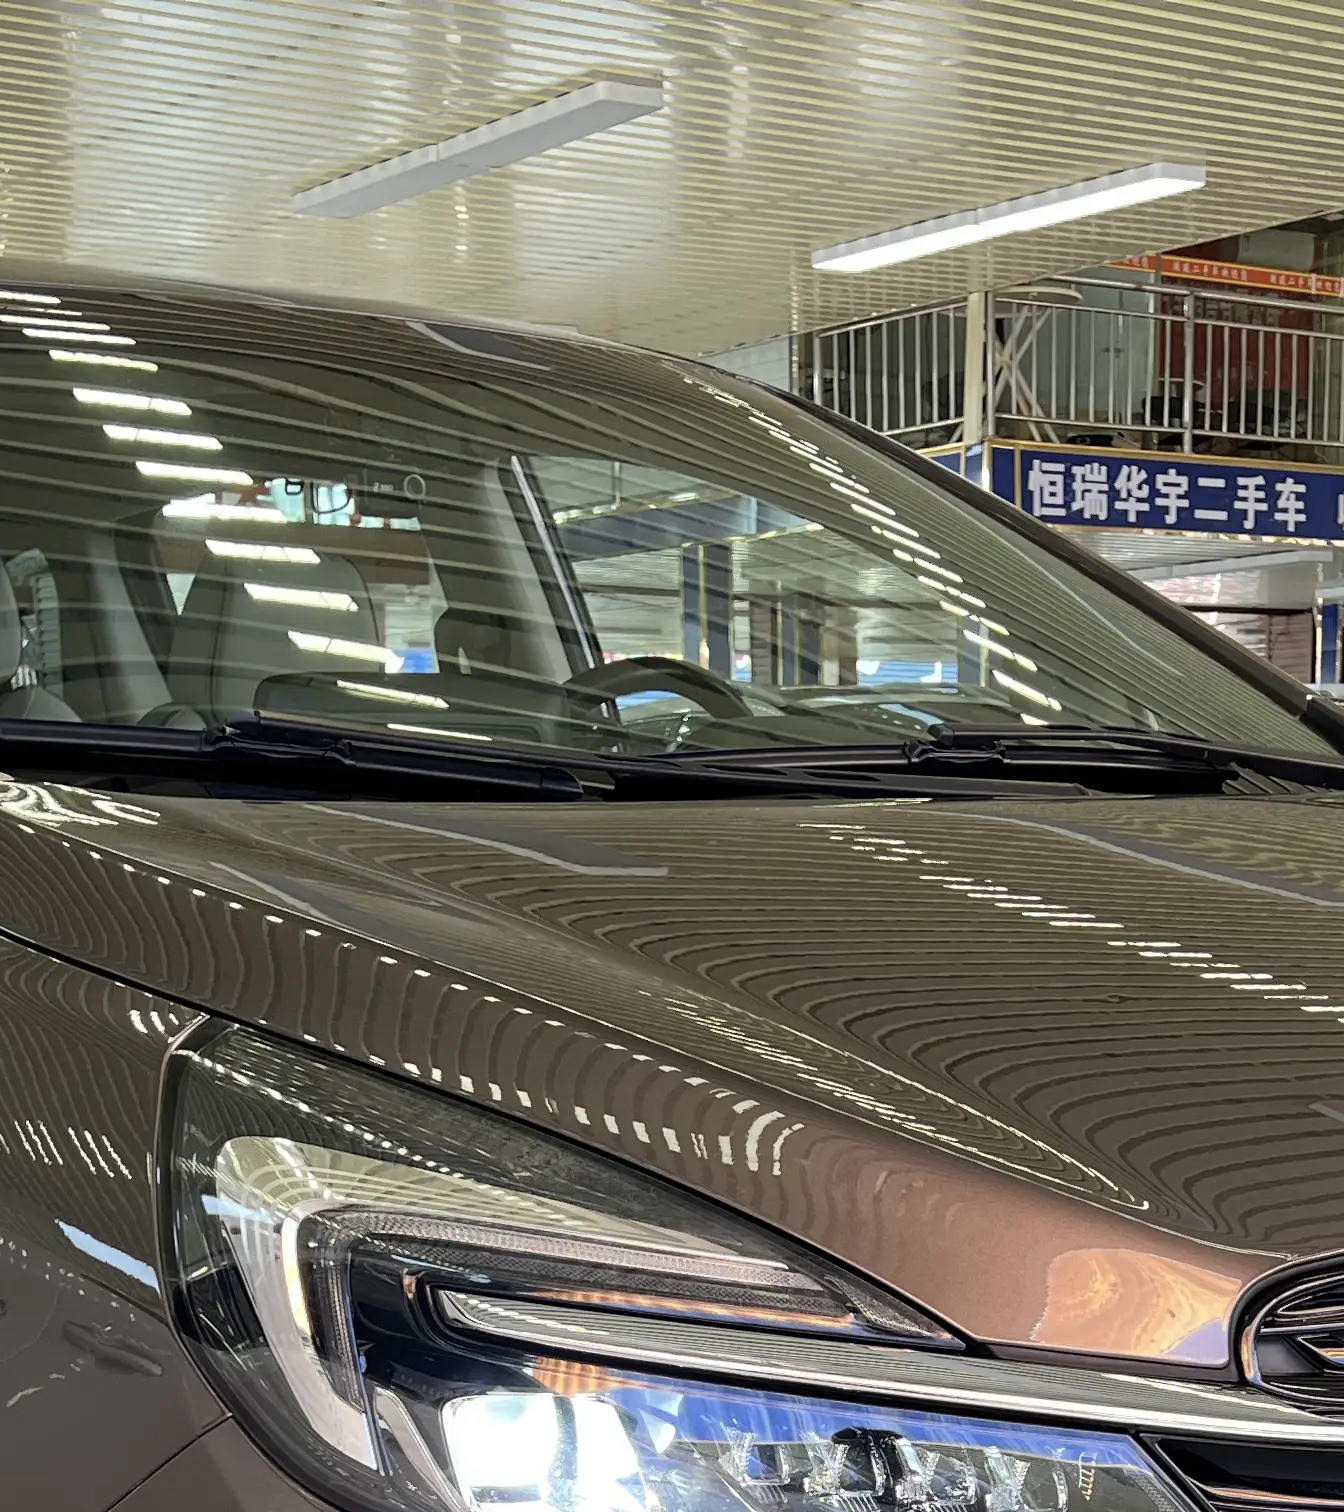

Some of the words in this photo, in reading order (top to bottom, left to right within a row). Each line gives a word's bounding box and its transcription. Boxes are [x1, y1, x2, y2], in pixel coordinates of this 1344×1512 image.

[1027, 459, 1307, 533] 恒瑞华宇二手车
